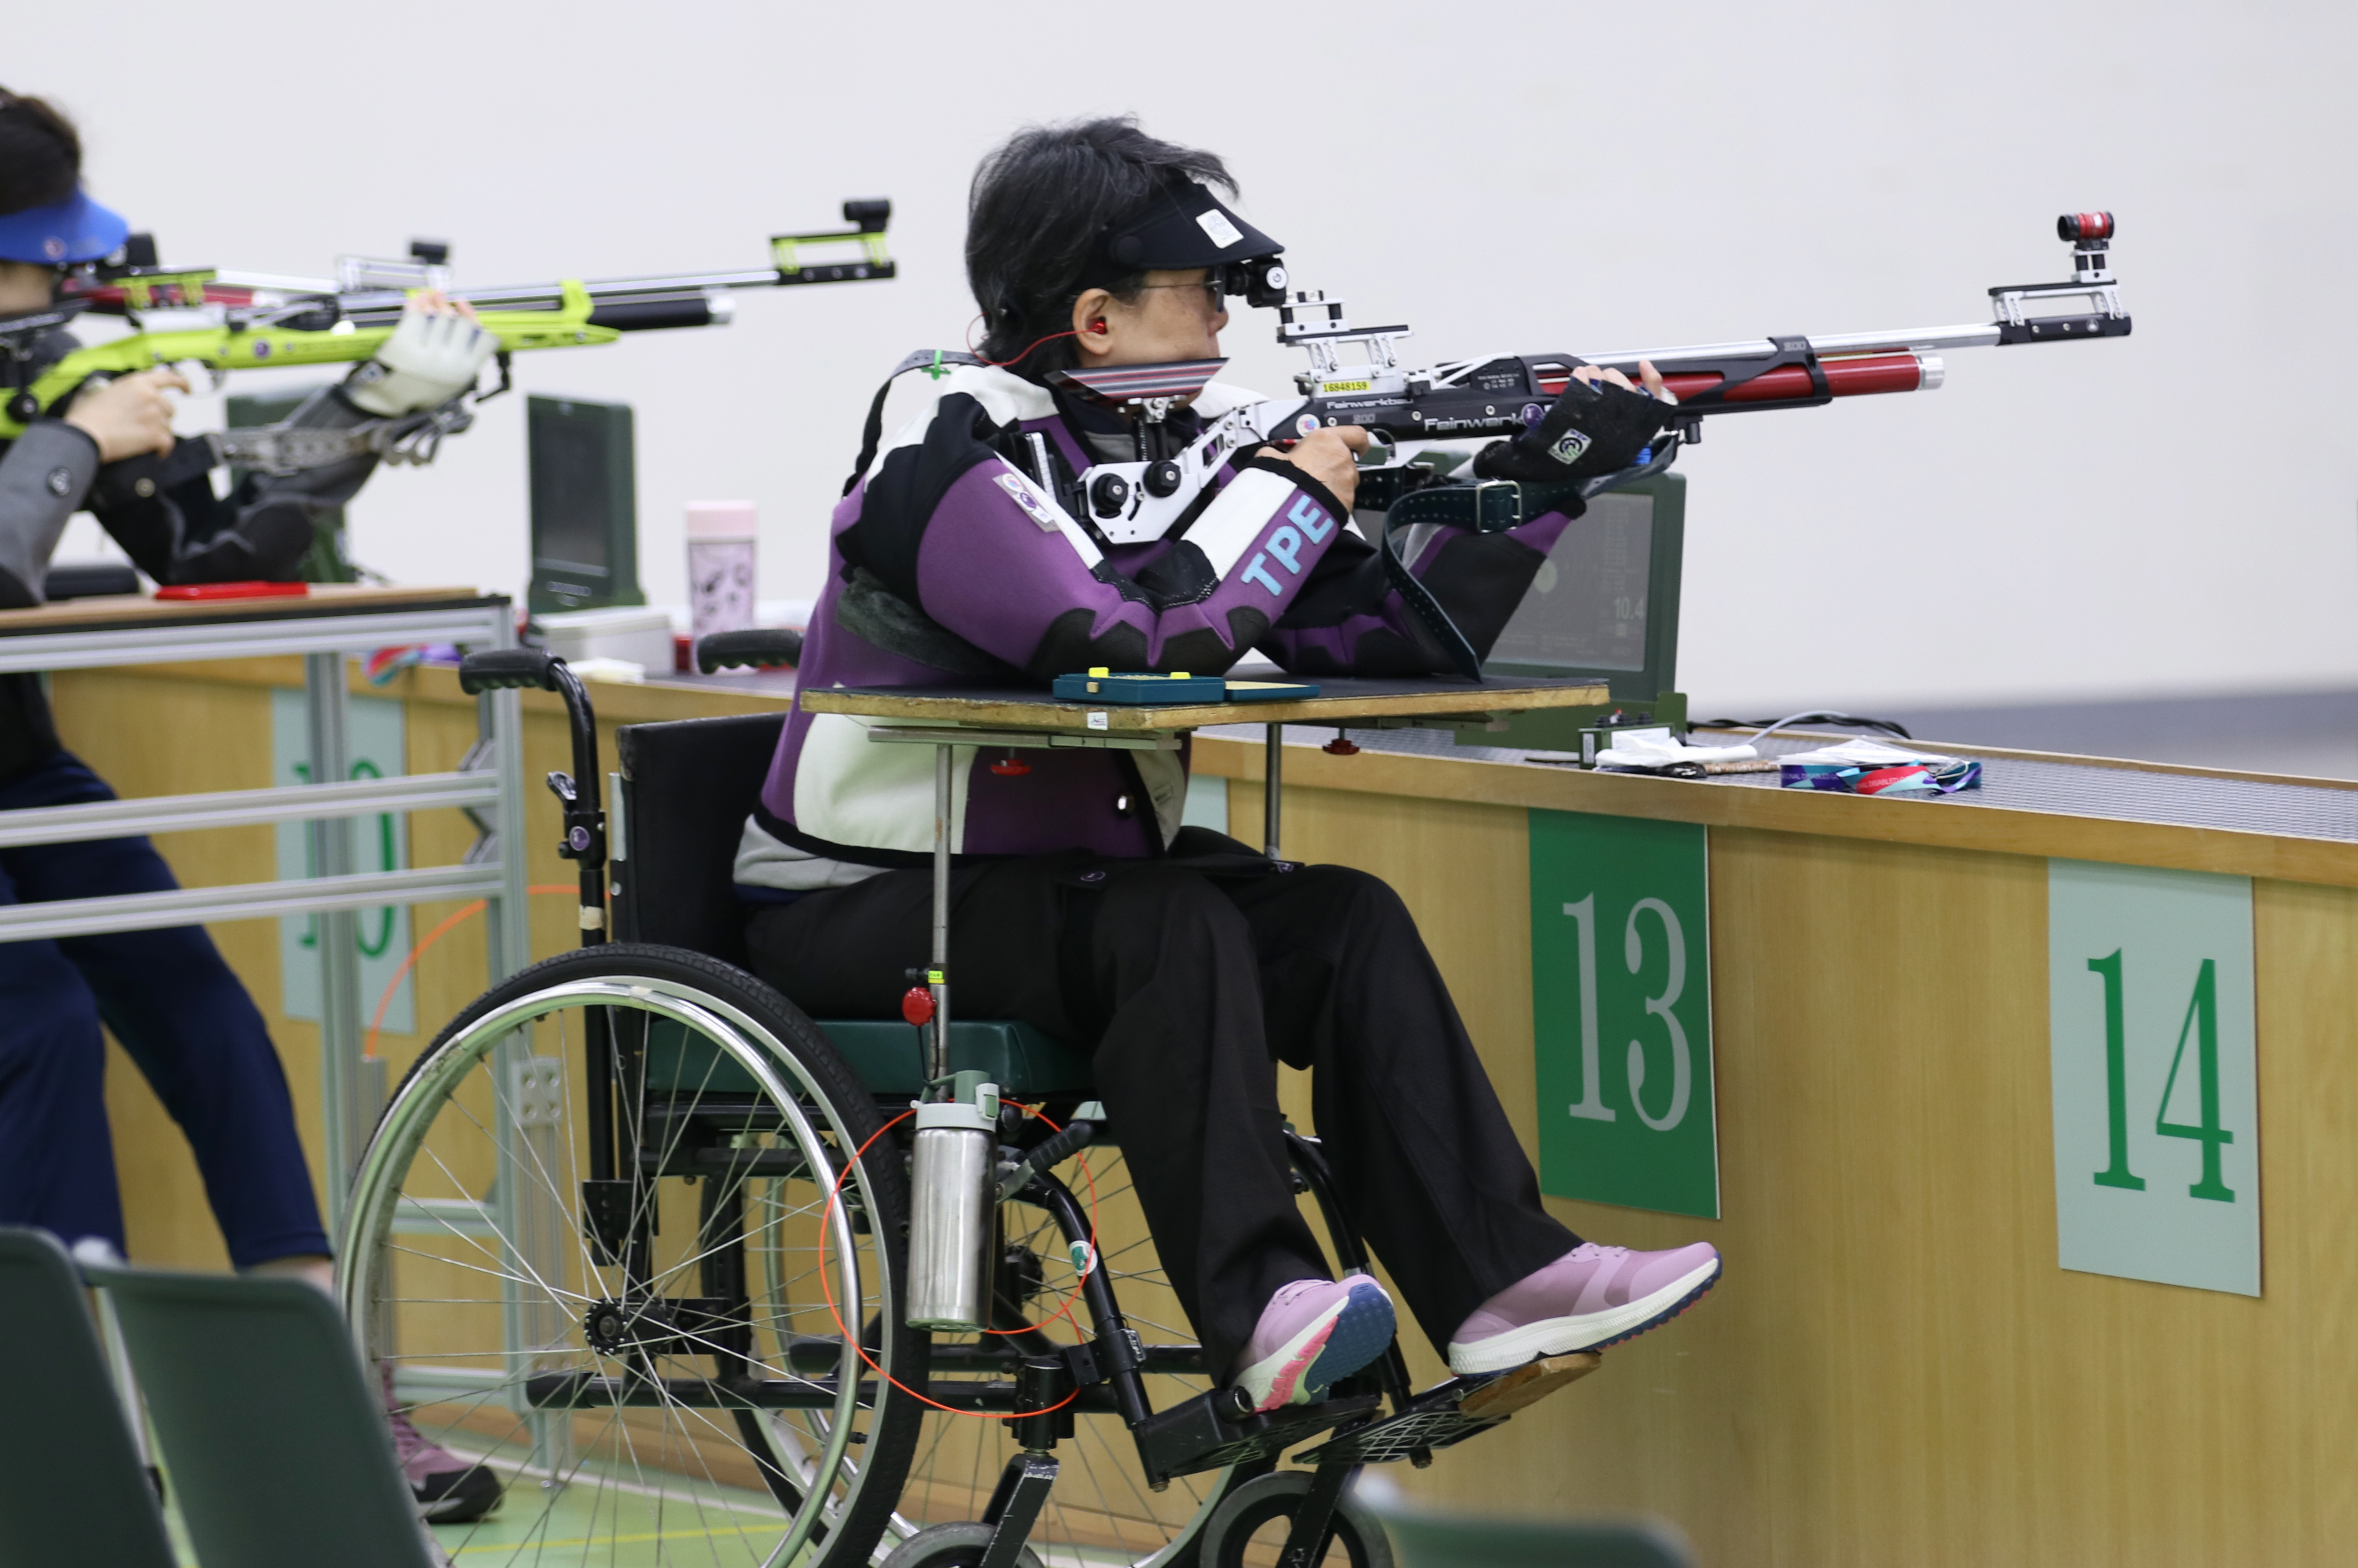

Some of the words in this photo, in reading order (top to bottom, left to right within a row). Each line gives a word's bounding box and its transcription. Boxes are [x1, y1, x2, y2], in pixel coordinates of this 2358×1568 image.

[1324, 381, 1367, 392] 16848159
[1424, 412, 1523, 432] Feinwerk
[1241, 494, 1334, 596] TPE
[1614, 596, 1644, 620] 10.4
[1563, 891, 1691, 1132] 13
[2087, 947, 2235, 1203] 14
